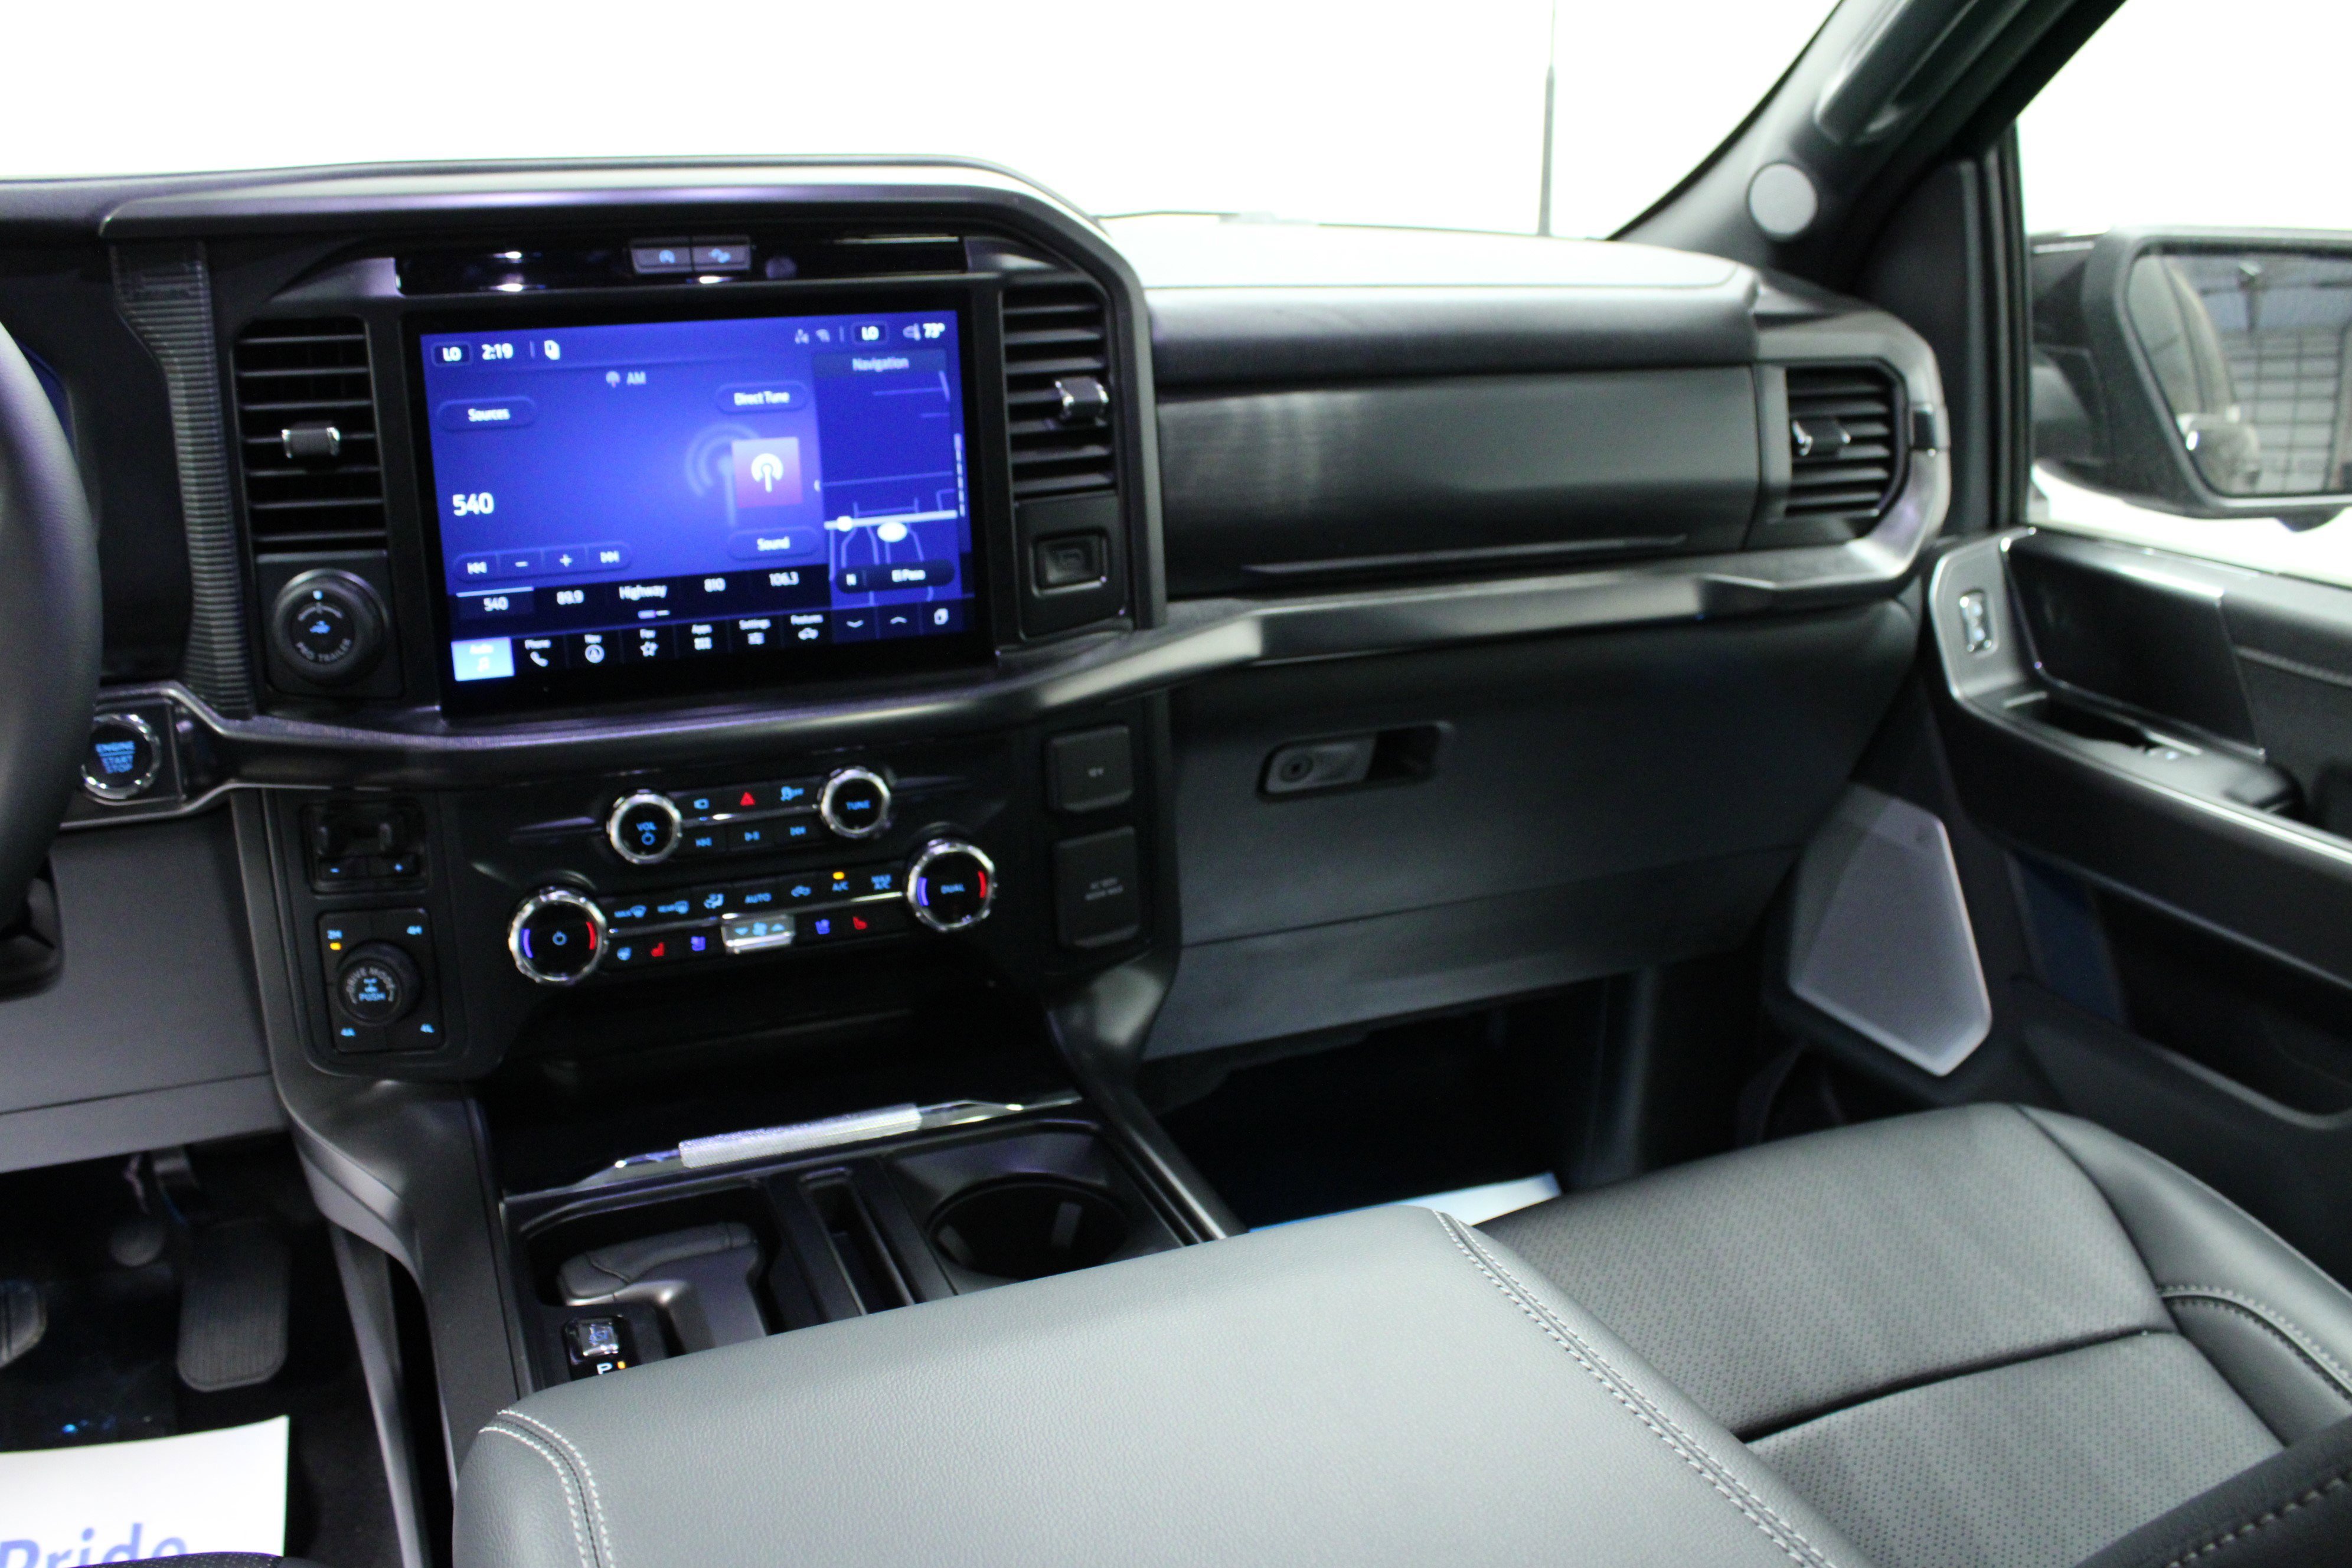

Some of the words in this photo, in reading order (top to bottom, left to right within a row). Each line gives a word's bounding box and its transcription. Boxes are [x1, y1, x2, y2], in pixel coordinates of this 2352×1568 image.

[443, 347, 461, 361] LO
[852, 357, 909, 373] Navigation
[627, 371, 646, 385] AM
[734, 392, 764, 406] Direct
[468, 408, 510, 422] Sources
[452, 492, 494, 516] 540
[757, 536, 790, 551] Sound
[619, 585, 667, 600] Highway
[484, 596, 508, 611] 540
[744, 892, 772, 904] AUTO
[596, 1363, 613, 1375] P
